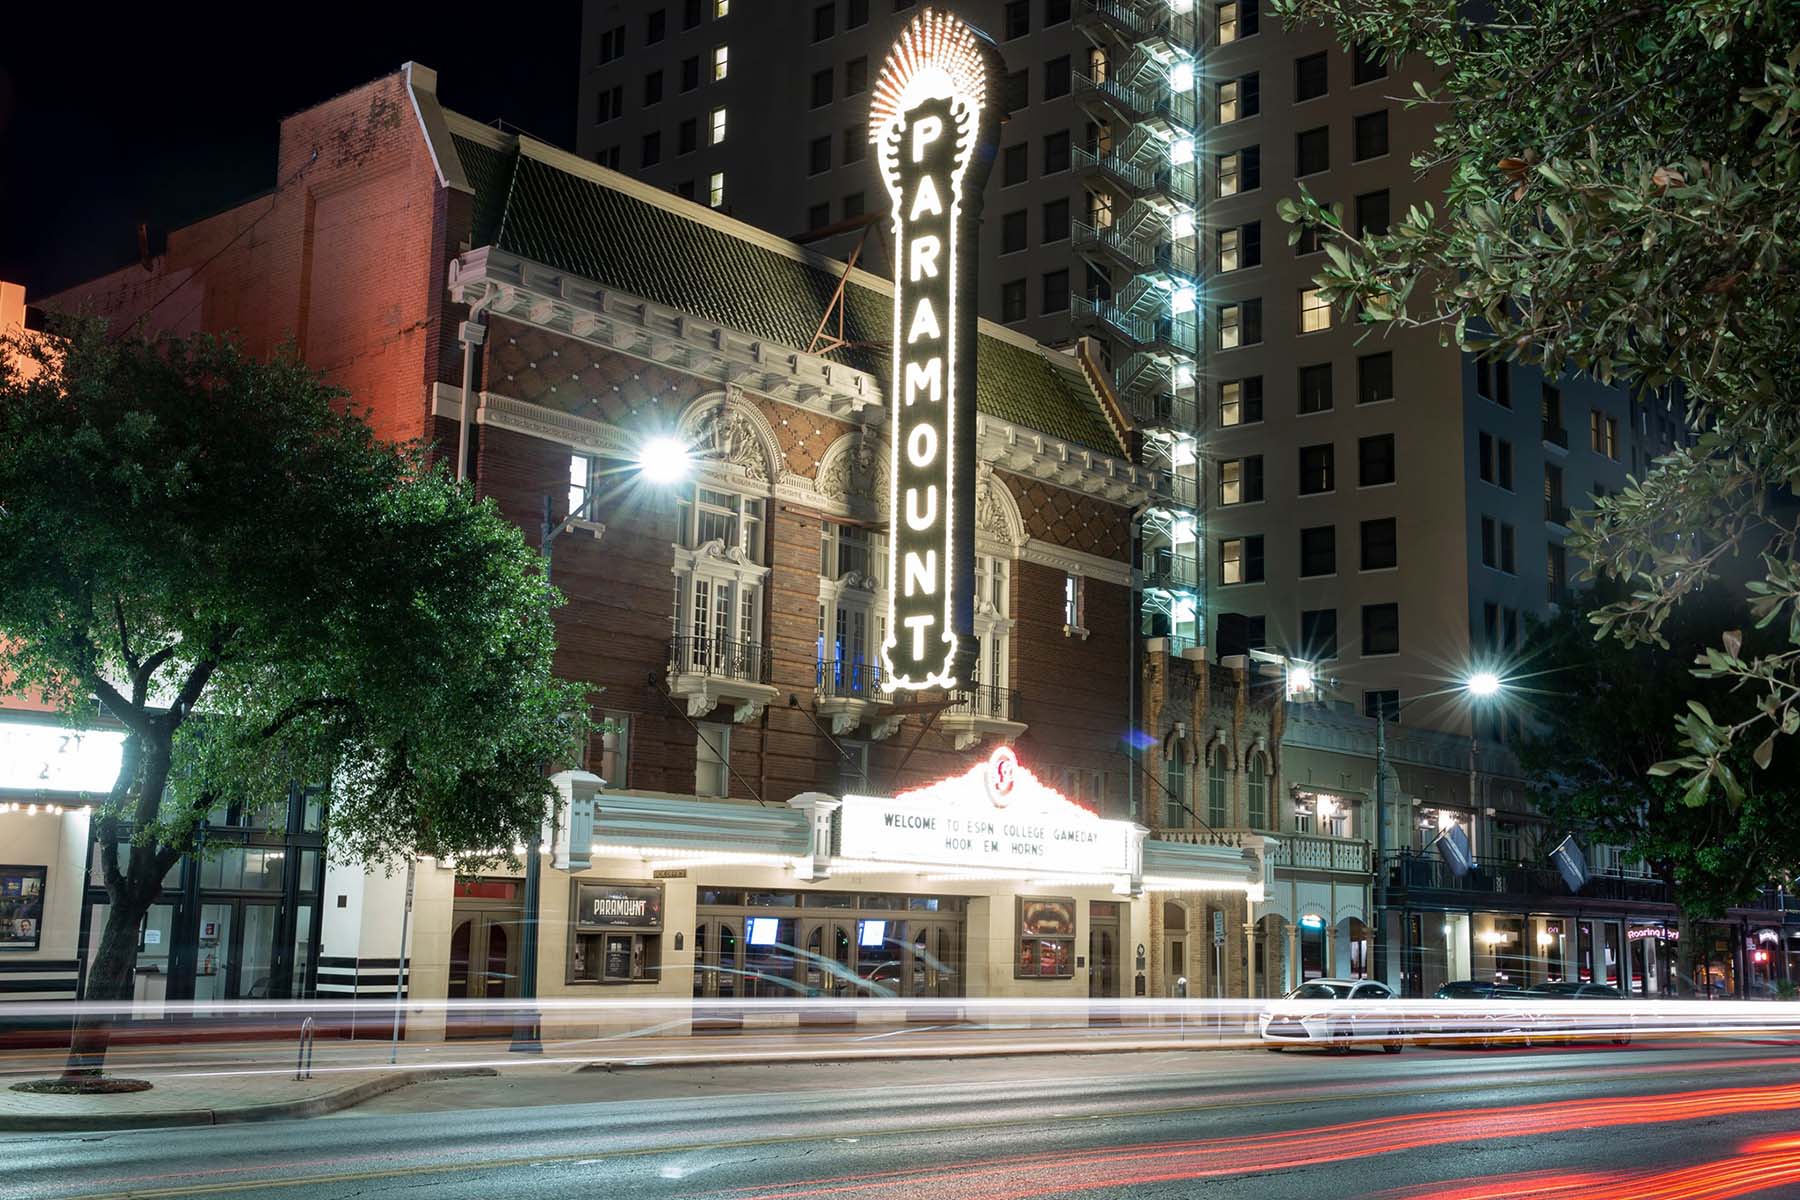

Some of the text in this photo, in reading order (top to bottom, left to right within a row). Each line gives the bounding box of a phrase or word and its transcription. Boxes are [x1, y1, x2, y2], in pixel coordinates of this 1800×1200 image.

[904, 115, 943, 661] PARAMOUNT
[884, 813, 1098, 843] WELCOME TO ESPN COLLEGE GAMEDAY
[945, 837, 972, 850] HOOK
[1011, 842, 1044, 856] HORNS
[594, 899, 647, 916] PARAMOUNT
[1627, 928, 1661, 939] Roaring
